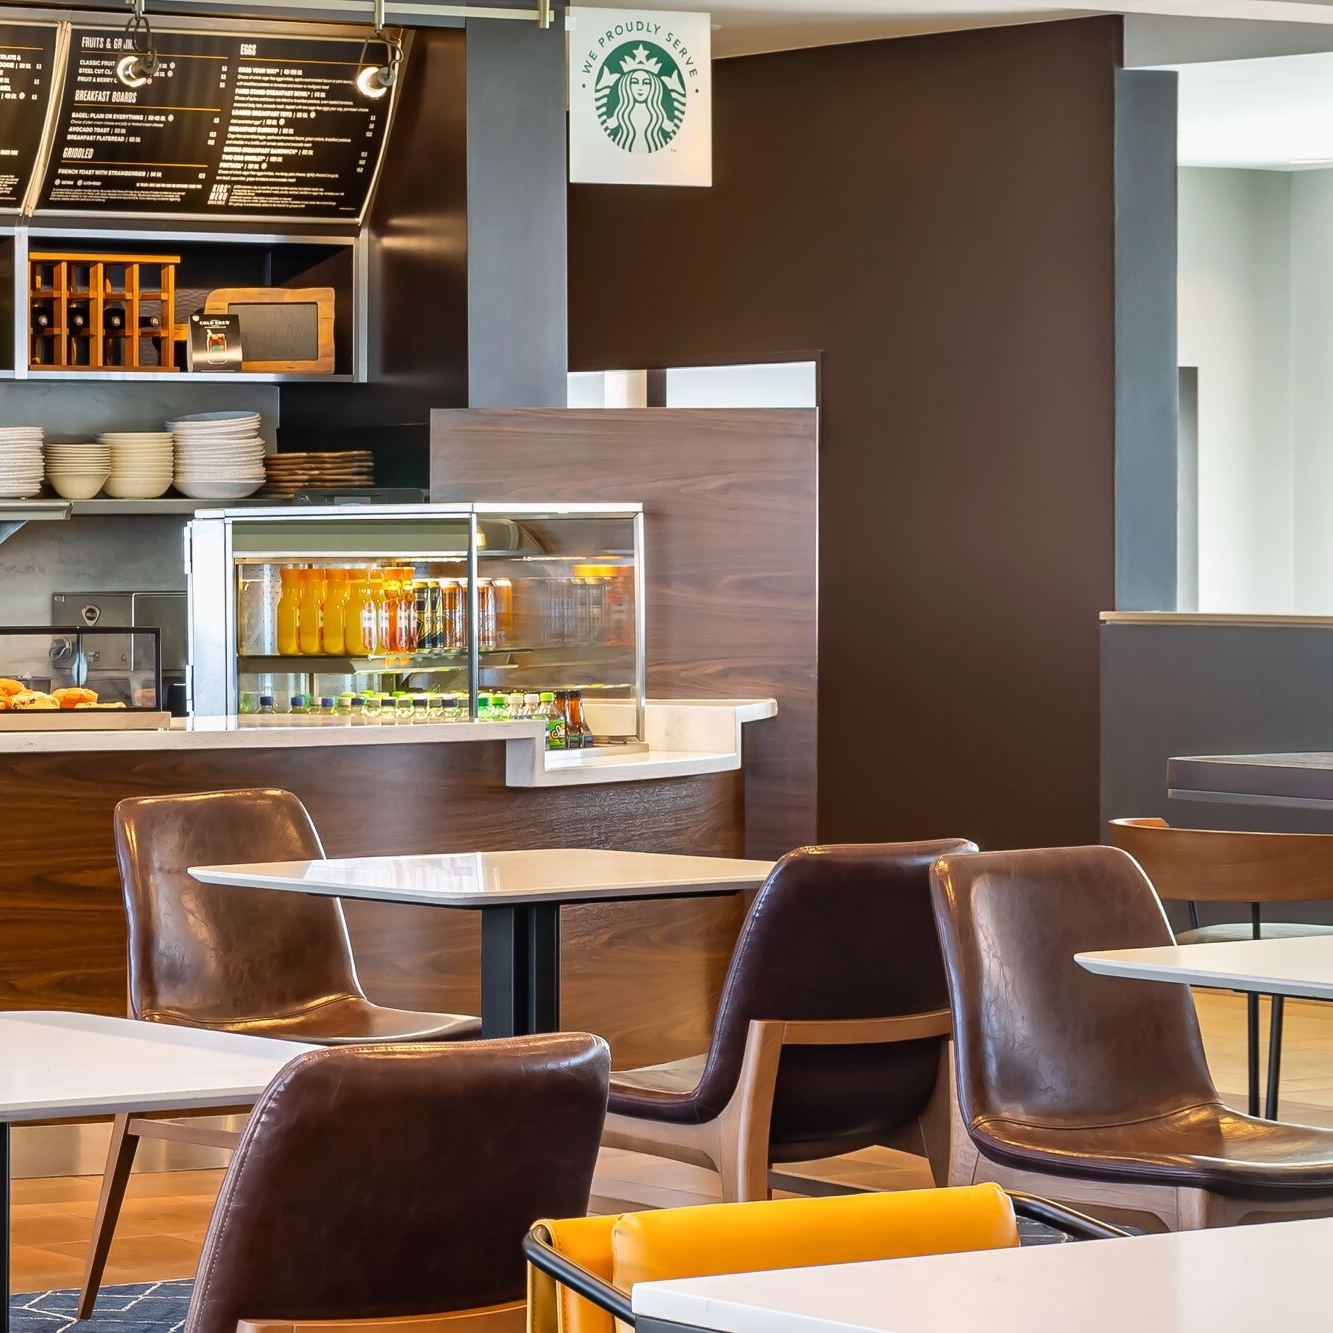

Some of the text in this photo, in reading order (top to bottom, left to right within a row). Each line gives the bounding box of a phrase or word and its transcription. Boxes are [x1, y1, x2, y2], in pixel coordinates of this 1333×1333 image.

[82, 37, 111, 49] FRUITS &
[583, 21, 698, 77] WE PROUDLY SERVE
[240, 44, 257, 55] EGGS
[75, 90, 137, 103] BREAKFAST BOARDS
[63, 148, 94, 159] GRIDDLED
